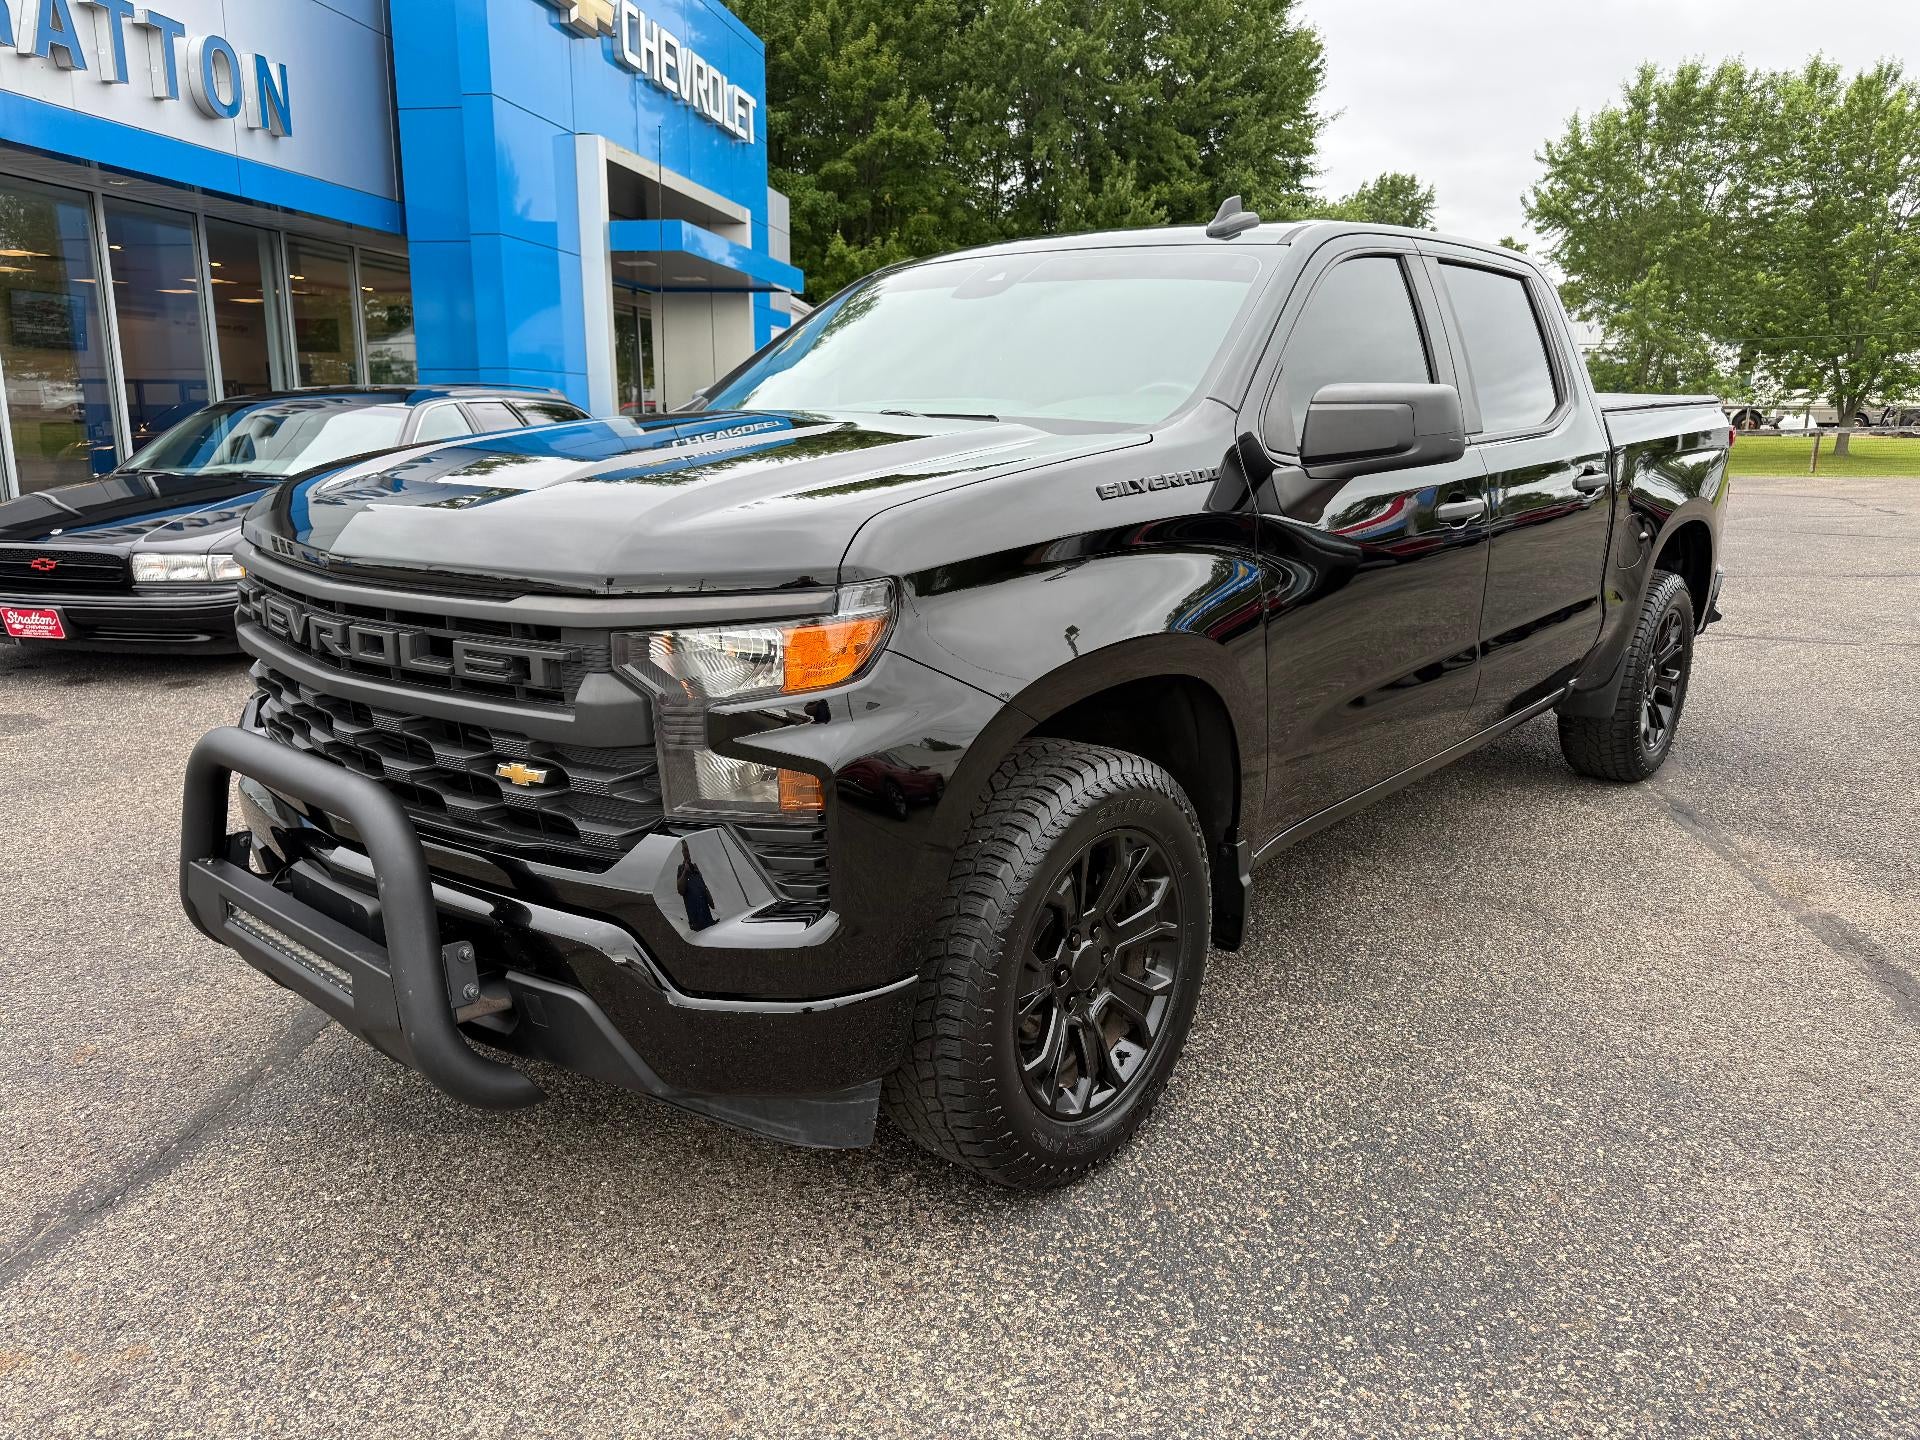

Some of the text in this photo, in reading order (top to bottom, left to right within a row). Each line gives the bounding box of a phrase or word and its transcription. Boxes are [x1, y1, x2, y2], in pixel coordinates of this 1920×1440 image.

[0, 0, 292, 137] ATTON
[614, 0, 757, 144] CHEVROLET
[1096, 465, 1222, 500] SILVERADO
[6, 610, 57, 625] Stratton
[237, 581, 583, 690] CHEVROLET
